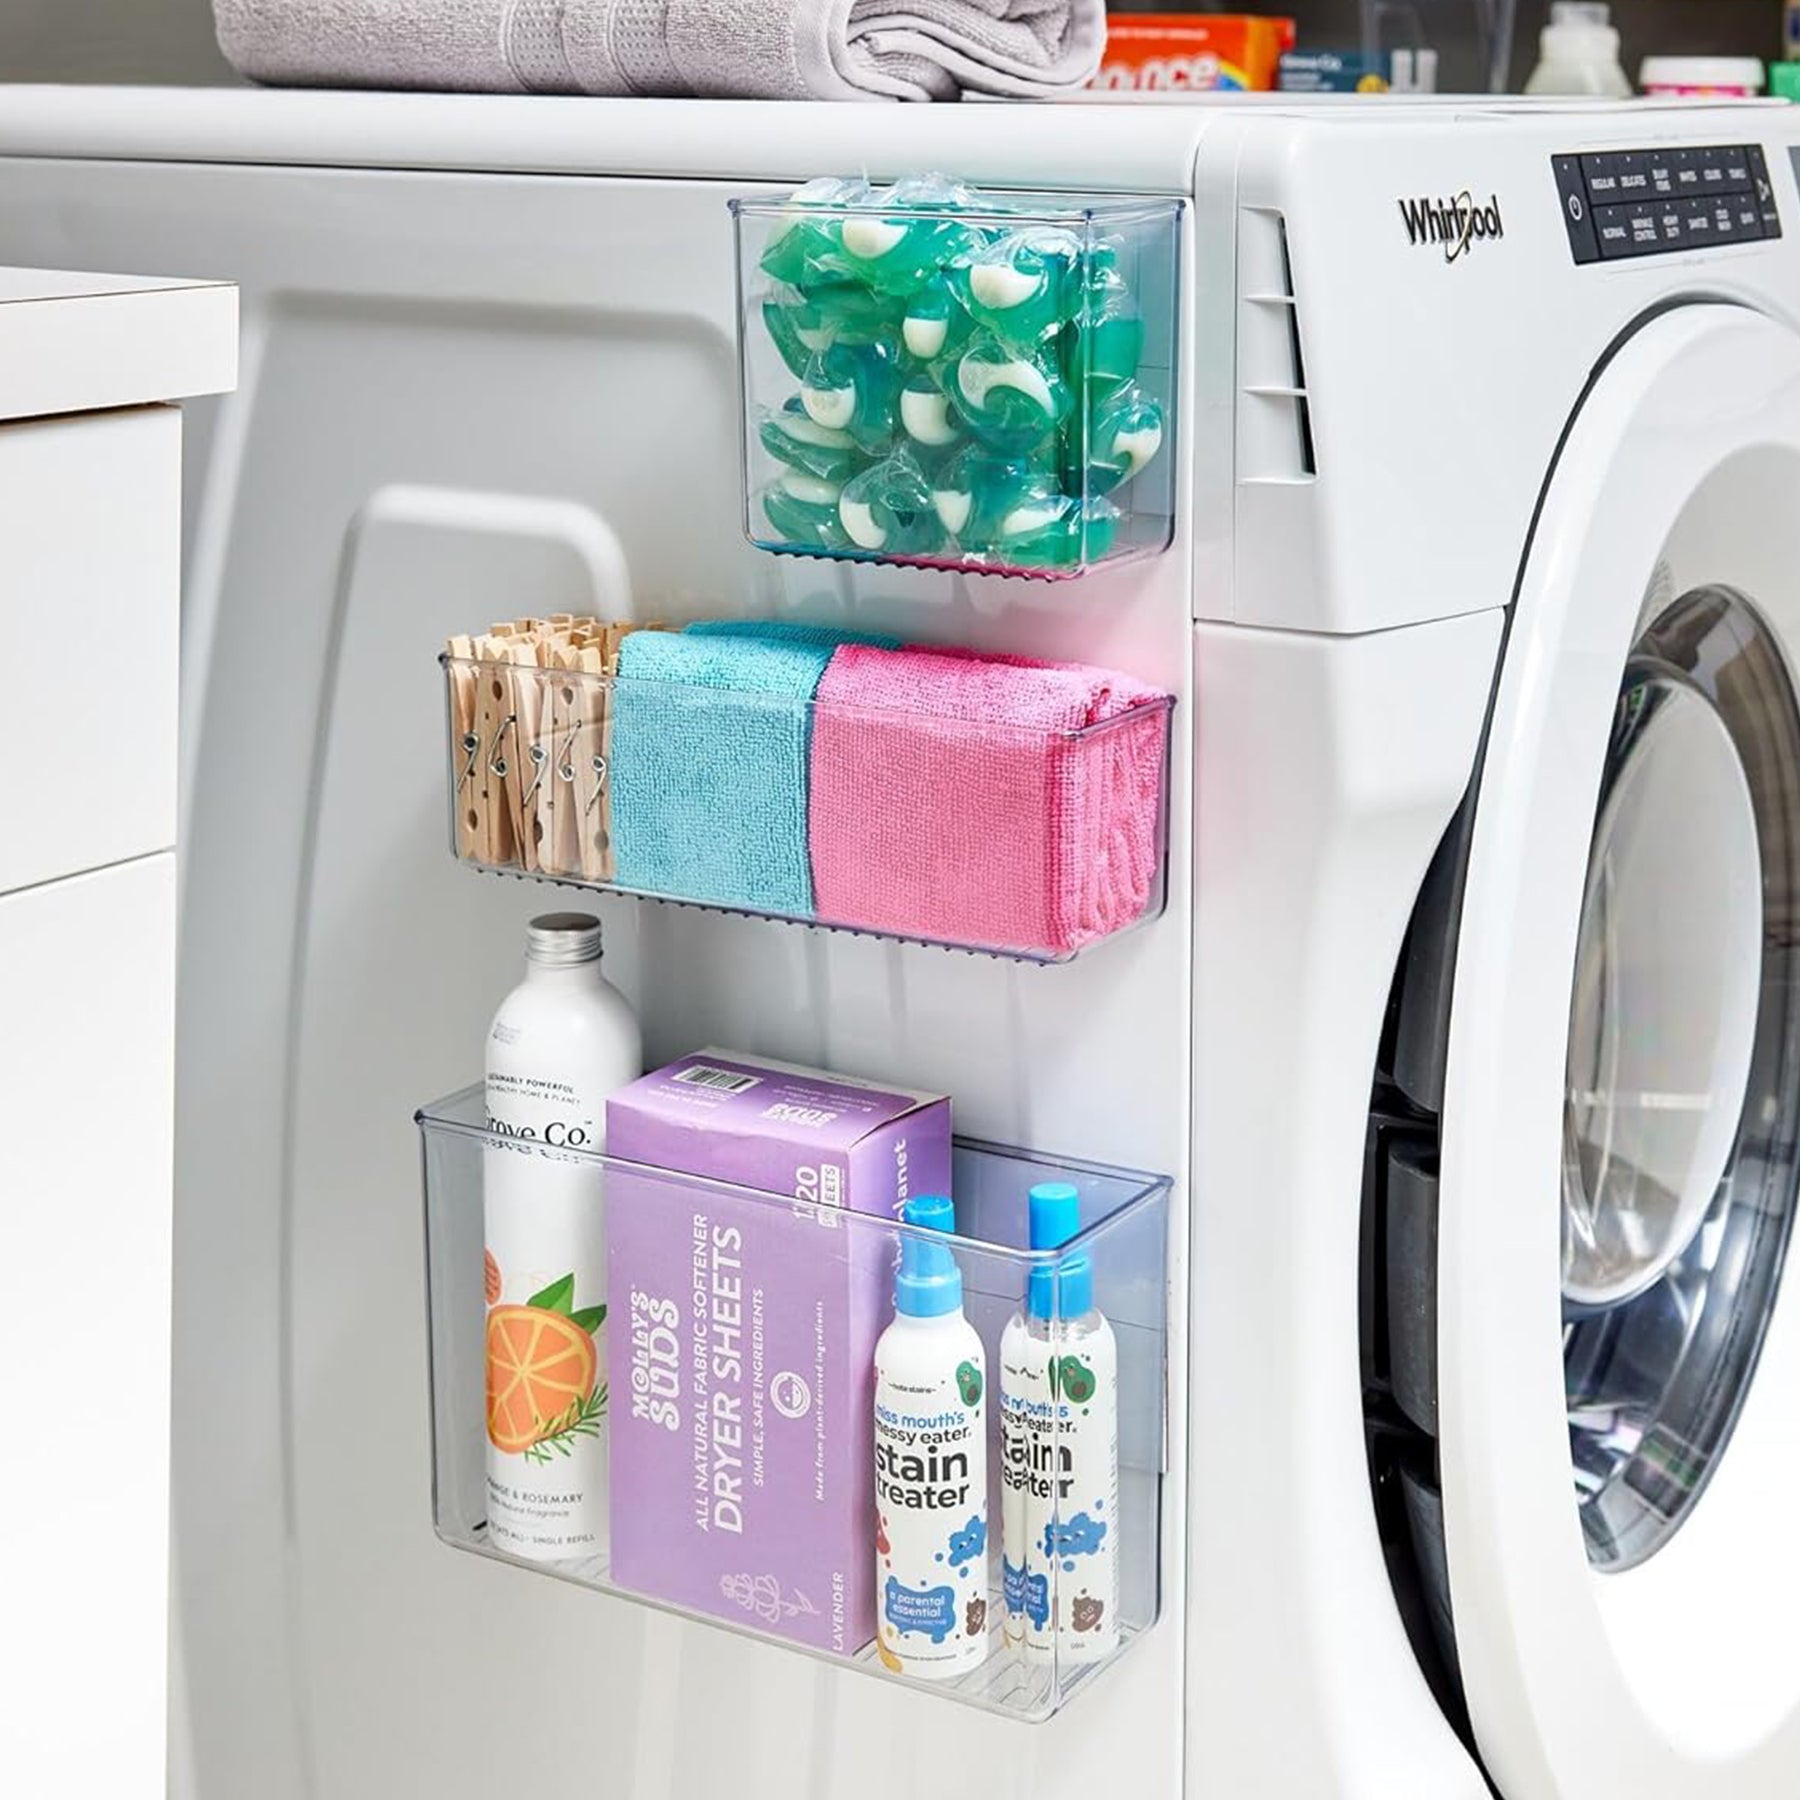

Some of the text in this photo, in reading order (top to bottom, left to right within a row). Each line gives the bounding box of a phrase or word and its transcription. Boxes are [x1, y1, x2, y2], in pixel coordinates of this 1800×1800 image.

[1398, 191, 1503, 258] Whirlpool
[526, 1079, 574, 1094] POWERFUL
[631, 1291, 650, 1421] MOLLY'S
[649, 1298, 680, 1432] SUDS
[752, 1288, 764, 1389] INGREDIENTS
[693, 1213, 709, 1533] ALL NATURAL FABRIC SOFTENER
[712, 1224, 743, 1535] DRYER SHEETS
[752, 1390, 764, 1428] SAFE
[814, 1300, 827, 1501] Made from plant-derived ingredients
[902, 1410, 965, 1429] mouth's
[876, 1443, 968, 1483] stain
[522, 1492, 584, 1505] ROSEMARY
[877, 1470, 971, 1510] treater
[832, 1571, 845, 1652] LAVENDER
[891, 1603, 942, 1618] essential
[897, 1593, 946, 1606] parental
